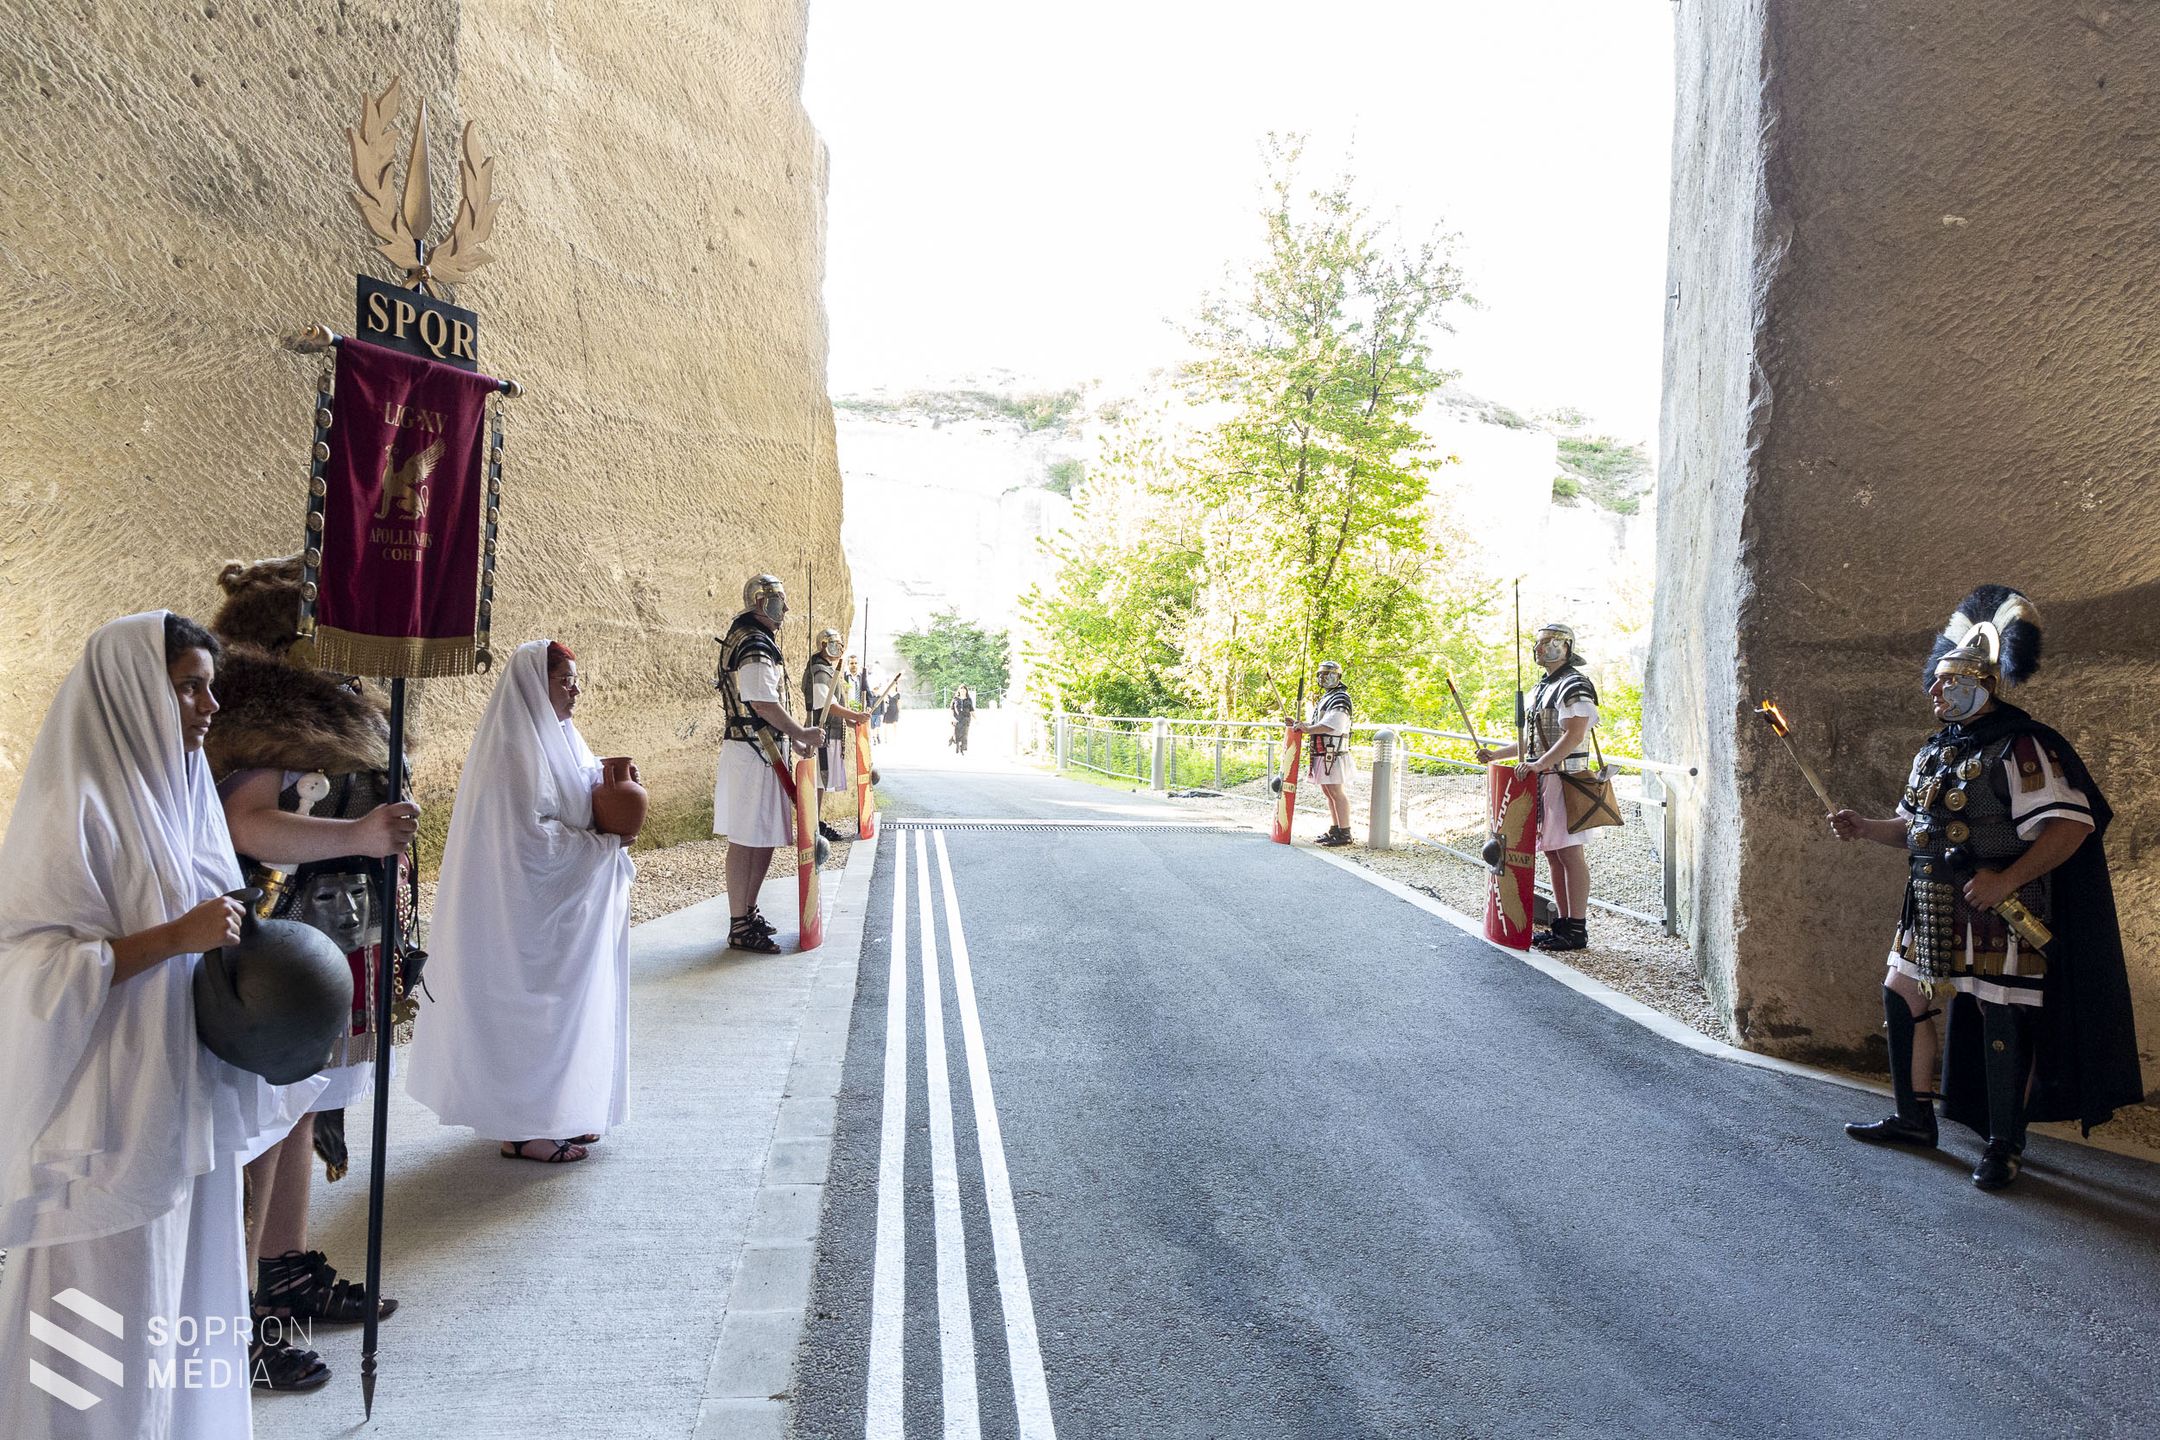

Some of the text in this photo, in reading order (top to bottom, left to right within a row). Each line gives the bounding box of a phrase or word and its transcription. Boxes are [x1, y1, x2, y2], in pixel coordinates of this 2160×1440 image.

[368, 292, 476, 360] SPQR
[382, 547, 412, 561] COH
[1508, 853, 1530, 865] XVAP
